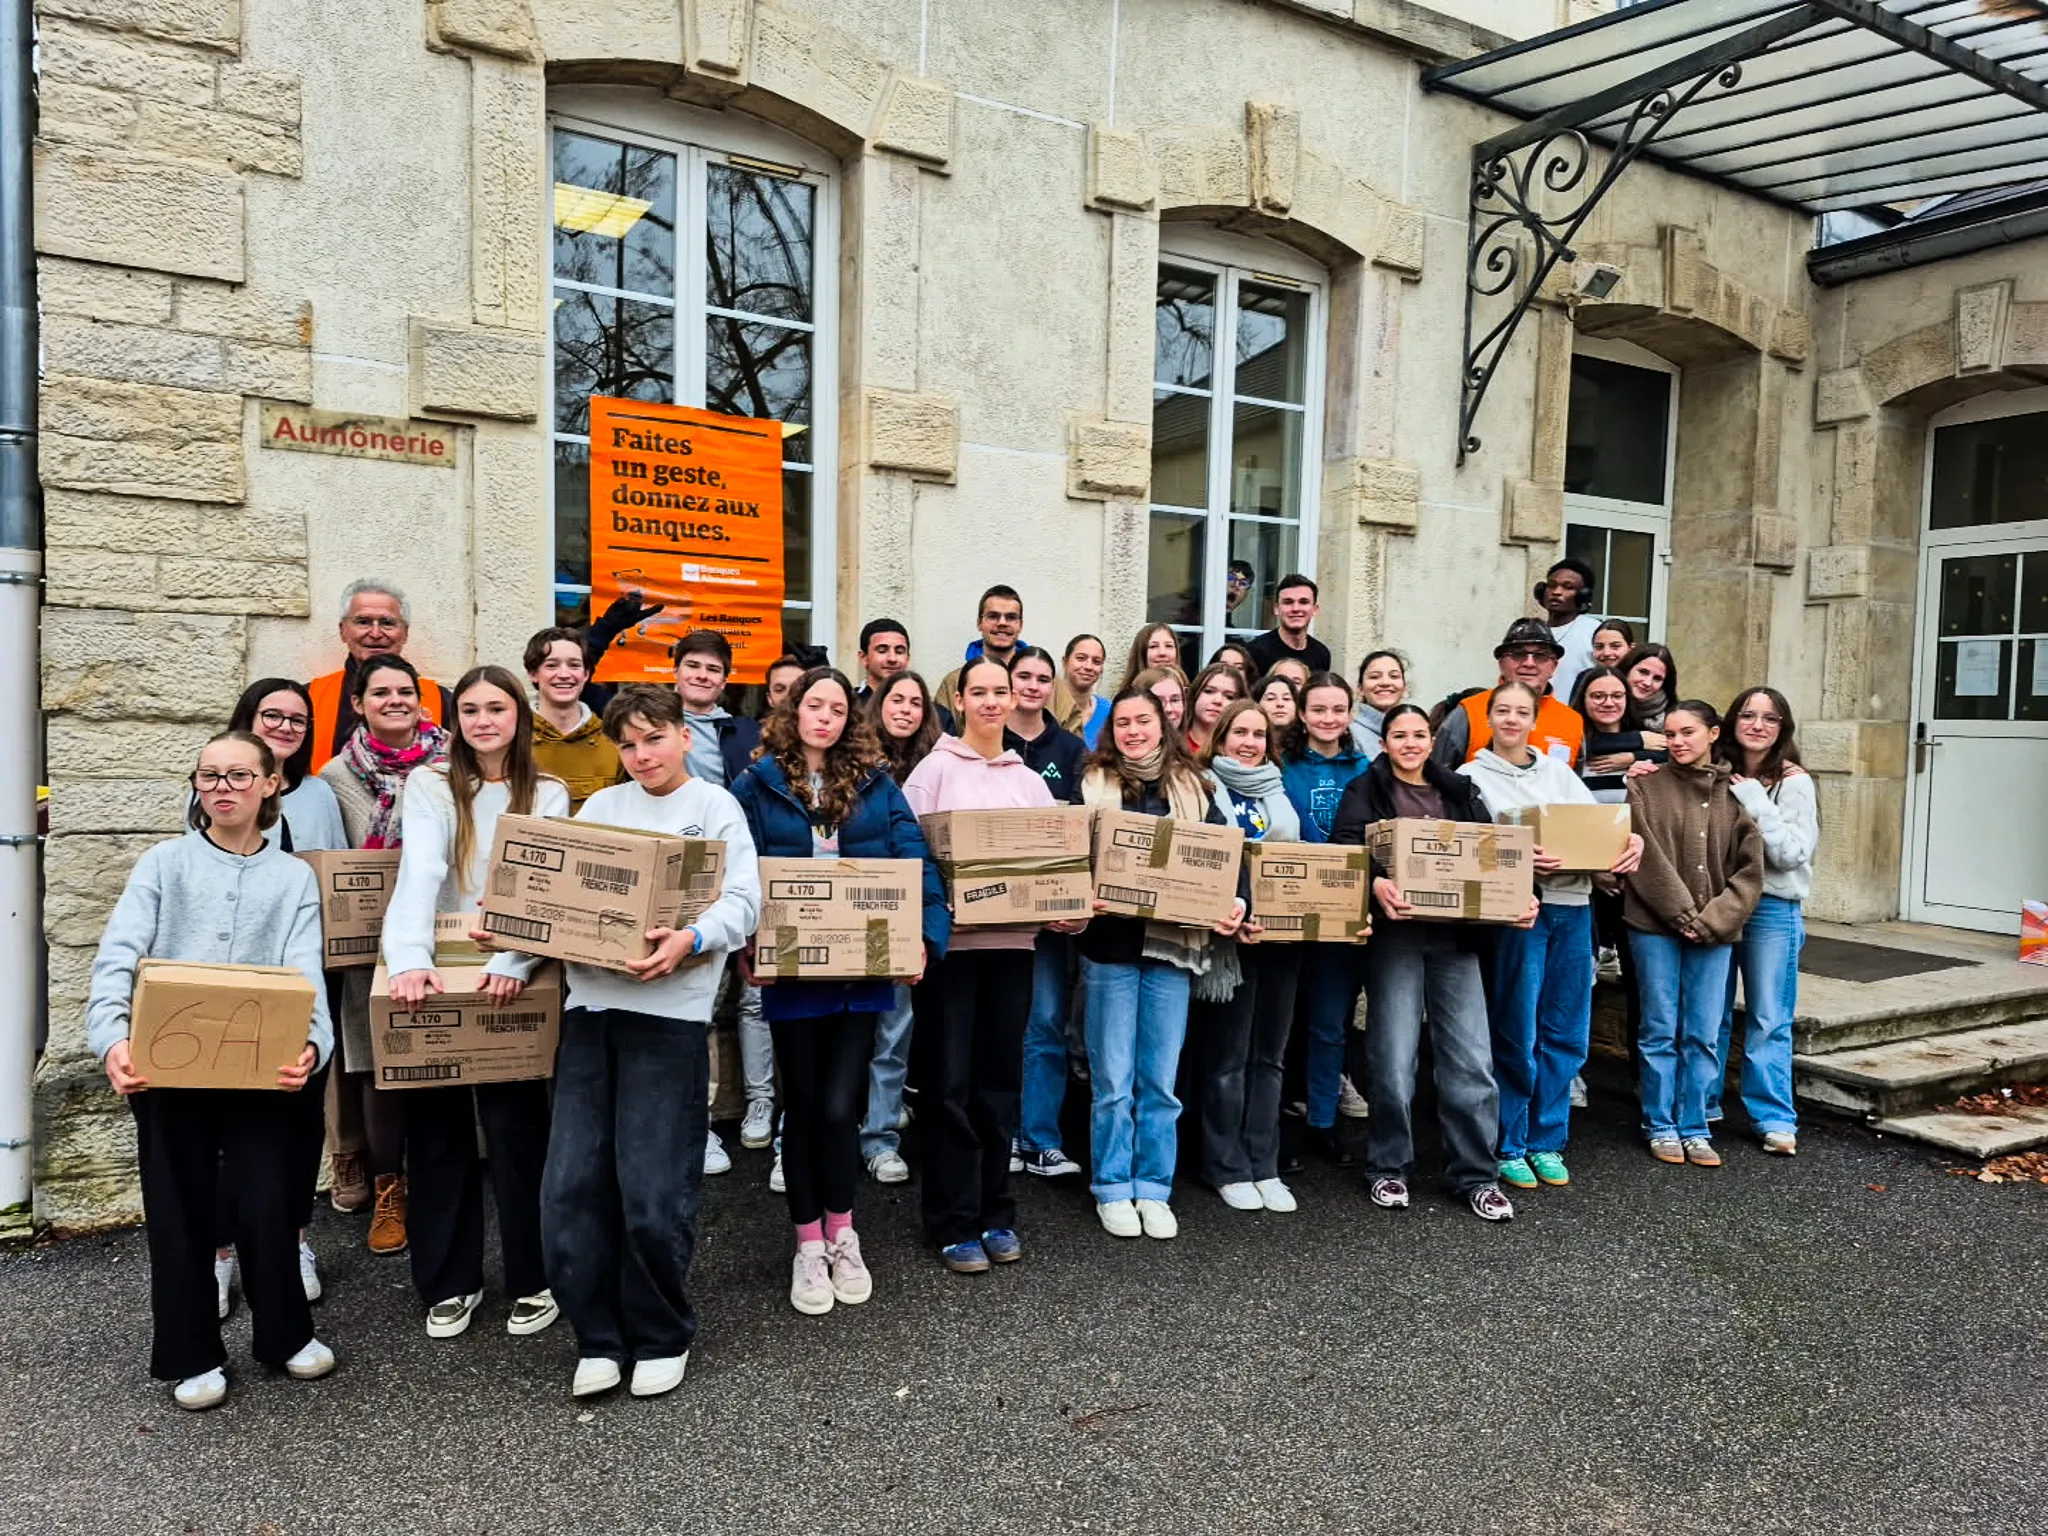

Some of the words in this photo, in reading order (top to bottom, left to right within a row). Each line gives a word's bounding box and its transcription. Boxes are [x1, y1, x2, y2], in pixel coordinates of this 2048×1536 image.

[273, 416, 446, 456] Aumônerie
[612, 428, 693, 456] Faites
[611, 459, 647, 479] un
[653, 464, 727, 489] geste,
[612, 484, 710, 513] donnez
[715, 499, 760, 518] aux
[612, 511, 731, 542] banques.
[700, 613, 718, 622] Les
[720, 614, 763, 625] Banques
[1128, 835, 1151, 847] 4.170
[519, 849, 547, 864] 4.170
[1182, 857, 1206, 868] FRENCH
[1206, 860, 1223, 870] FRIES
[1274, 865, 1295, 875] 4.170
[348, 877, 370, 887] 4.170
[581, 877, 608, 892] FRENCH
[609, 882, 630, 896] FRIES
[787, 885, 815, 896] 4.170
[966, 884, 1006, 901] FRAGILE
[852, 901, 879, 911] FRENCH
[880, 901, 899, 911] FRIES
[410, 1014, 442, 1025] 4.170
[485, 1025, 515, 1034] FRENCH
[516, 1024, 539, 1032] FRIES
[149, 1000, 262, 1074] 6A
